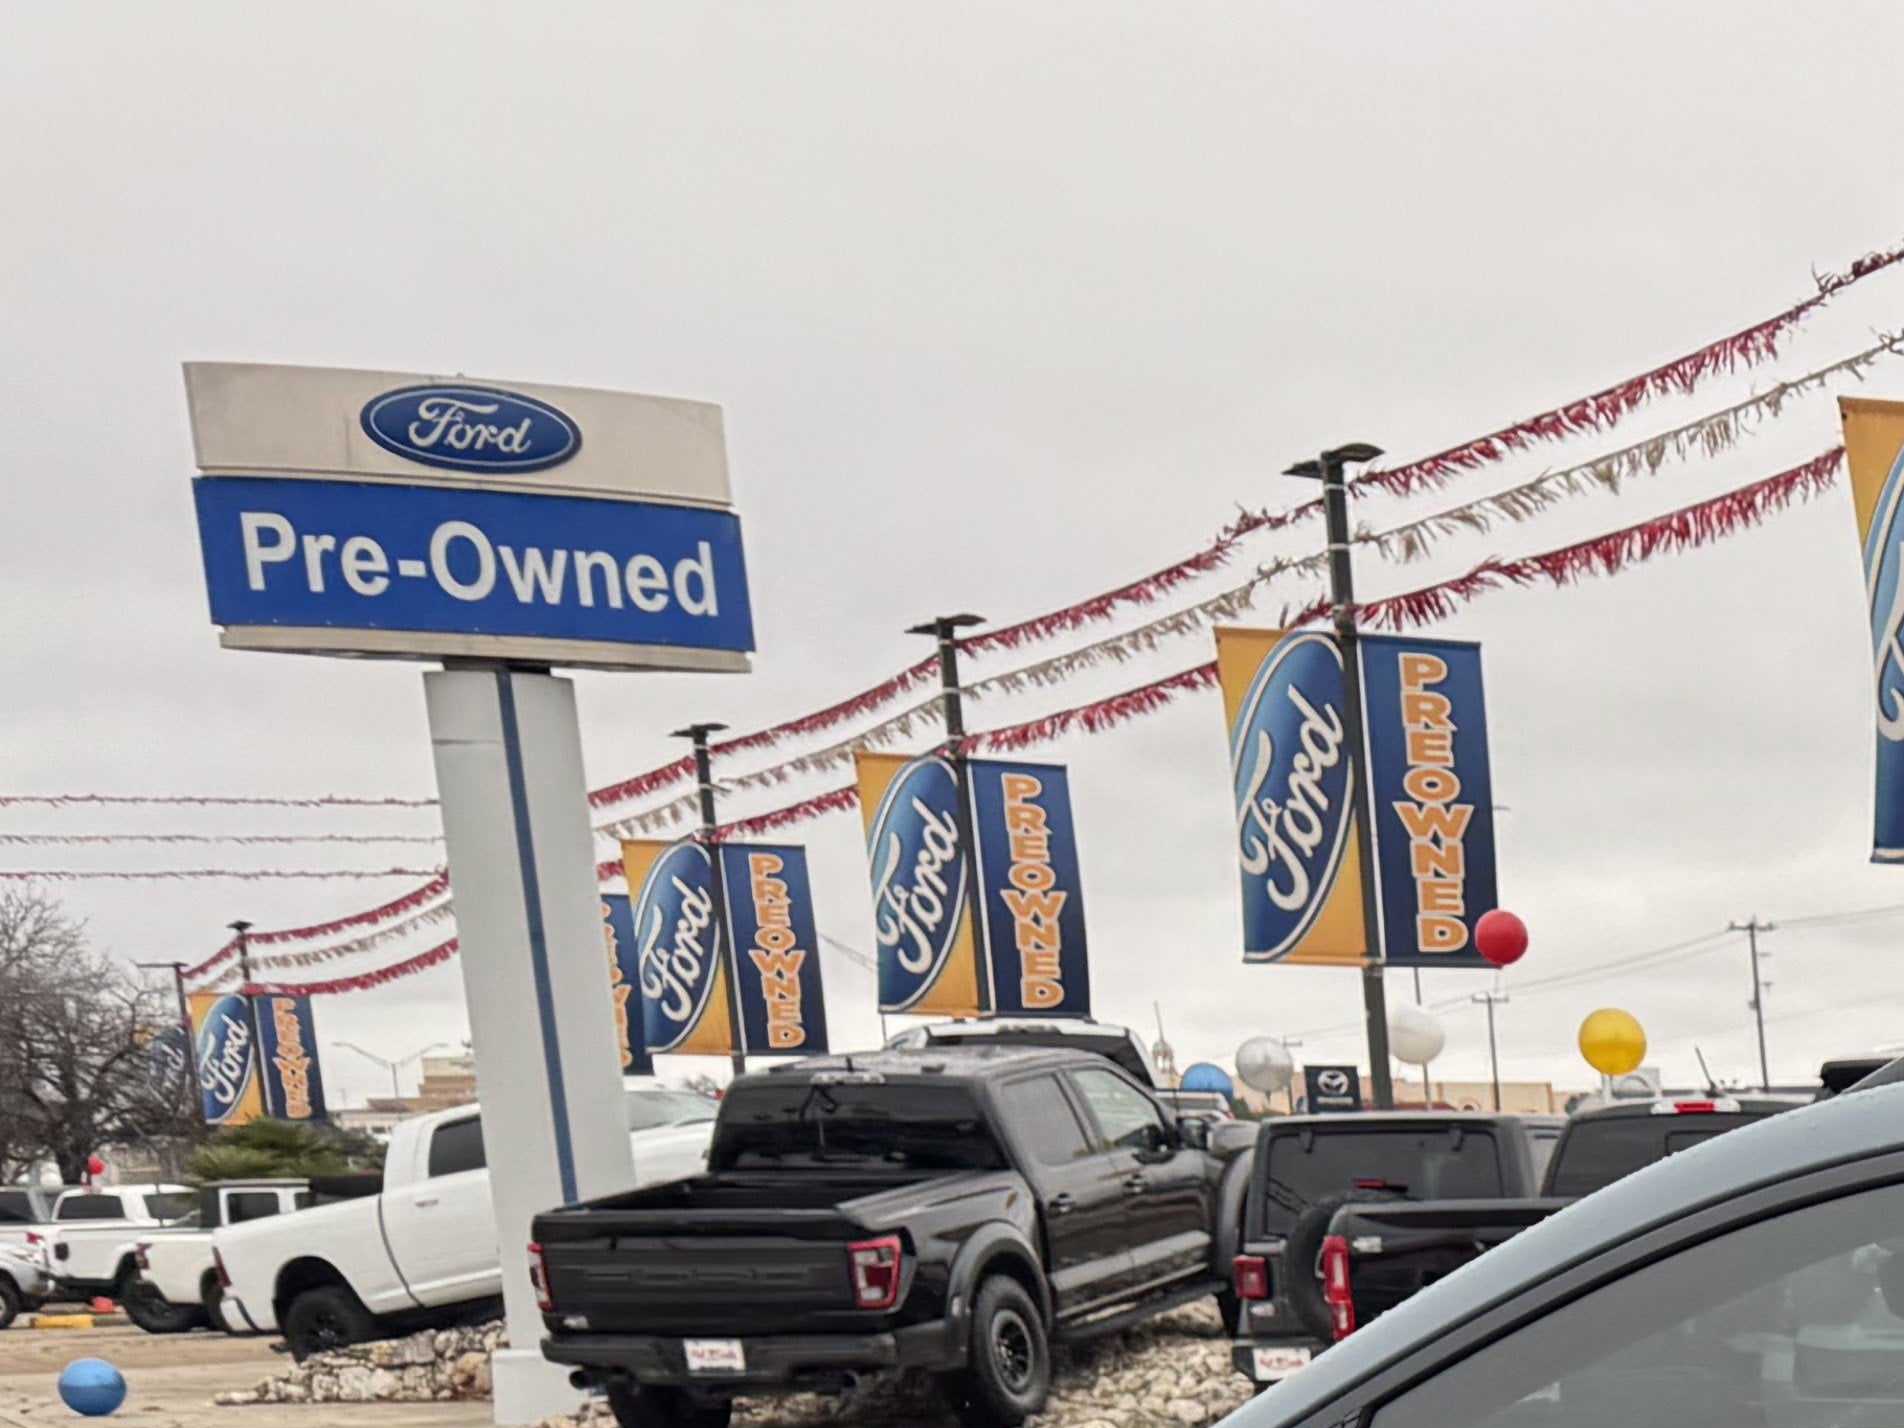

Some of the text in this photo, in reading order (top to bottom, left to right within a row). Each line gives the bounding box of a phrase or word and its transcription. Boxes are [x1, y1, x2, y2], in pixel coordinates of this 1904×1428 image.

[408, 398, 533, 454] Ford
[240, 511, 718, 617] Pre-Owned
[1239, 684, 1345, 911] Ford
[1393, 652, 1475, 952] PREOWNED
[640, 876, 713, 1022] Ford
[748, 853, 806, 1048] PREOWNED
[876, 799, 959, 974] Ford
[1000, 773, 1066, 1009] PREOWNED
[200, 1015, 249, 1103] Ford
